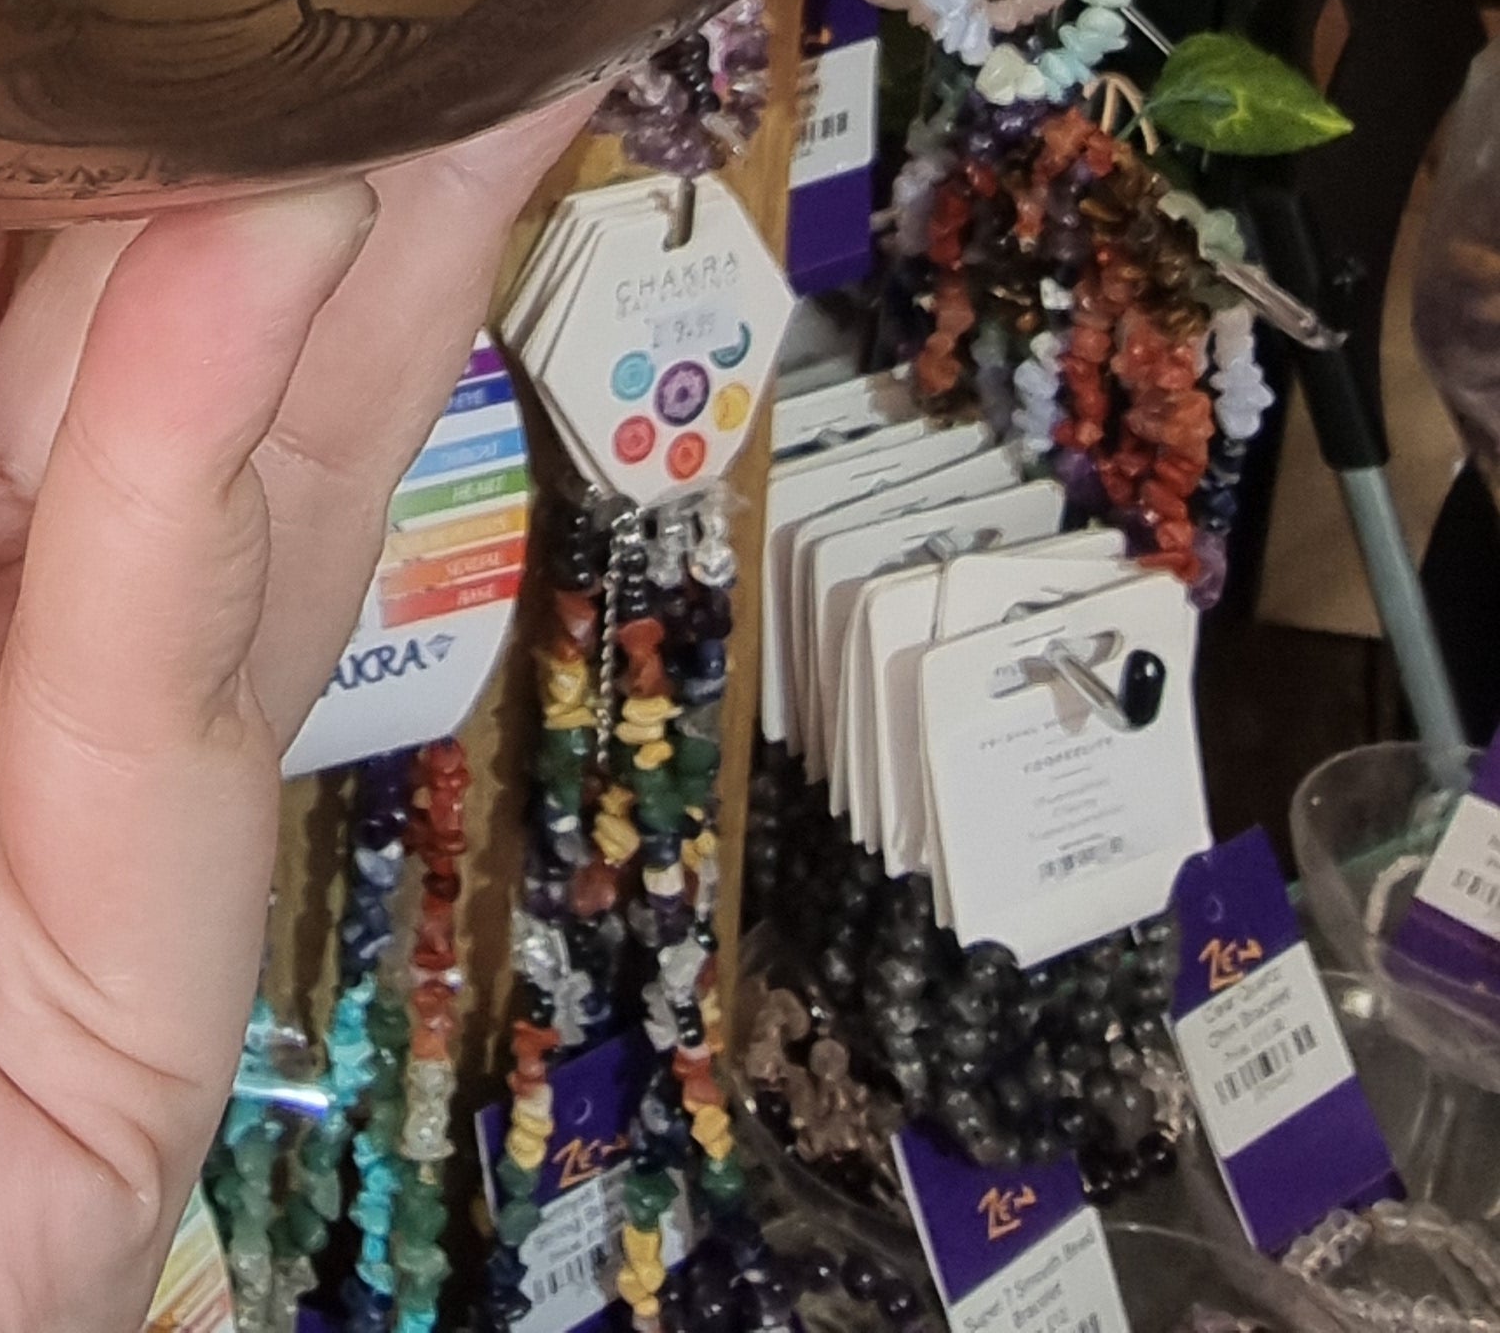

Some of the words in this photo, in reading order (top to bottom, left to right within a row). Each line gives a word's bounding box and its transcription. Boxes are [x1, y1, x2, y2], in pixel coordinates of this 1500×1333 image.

[614, 249, 740, 307] CHAKRA
[1199, 937, 1264, 992] ZEN
[977, 1183, 1038, 1241] ZEN
